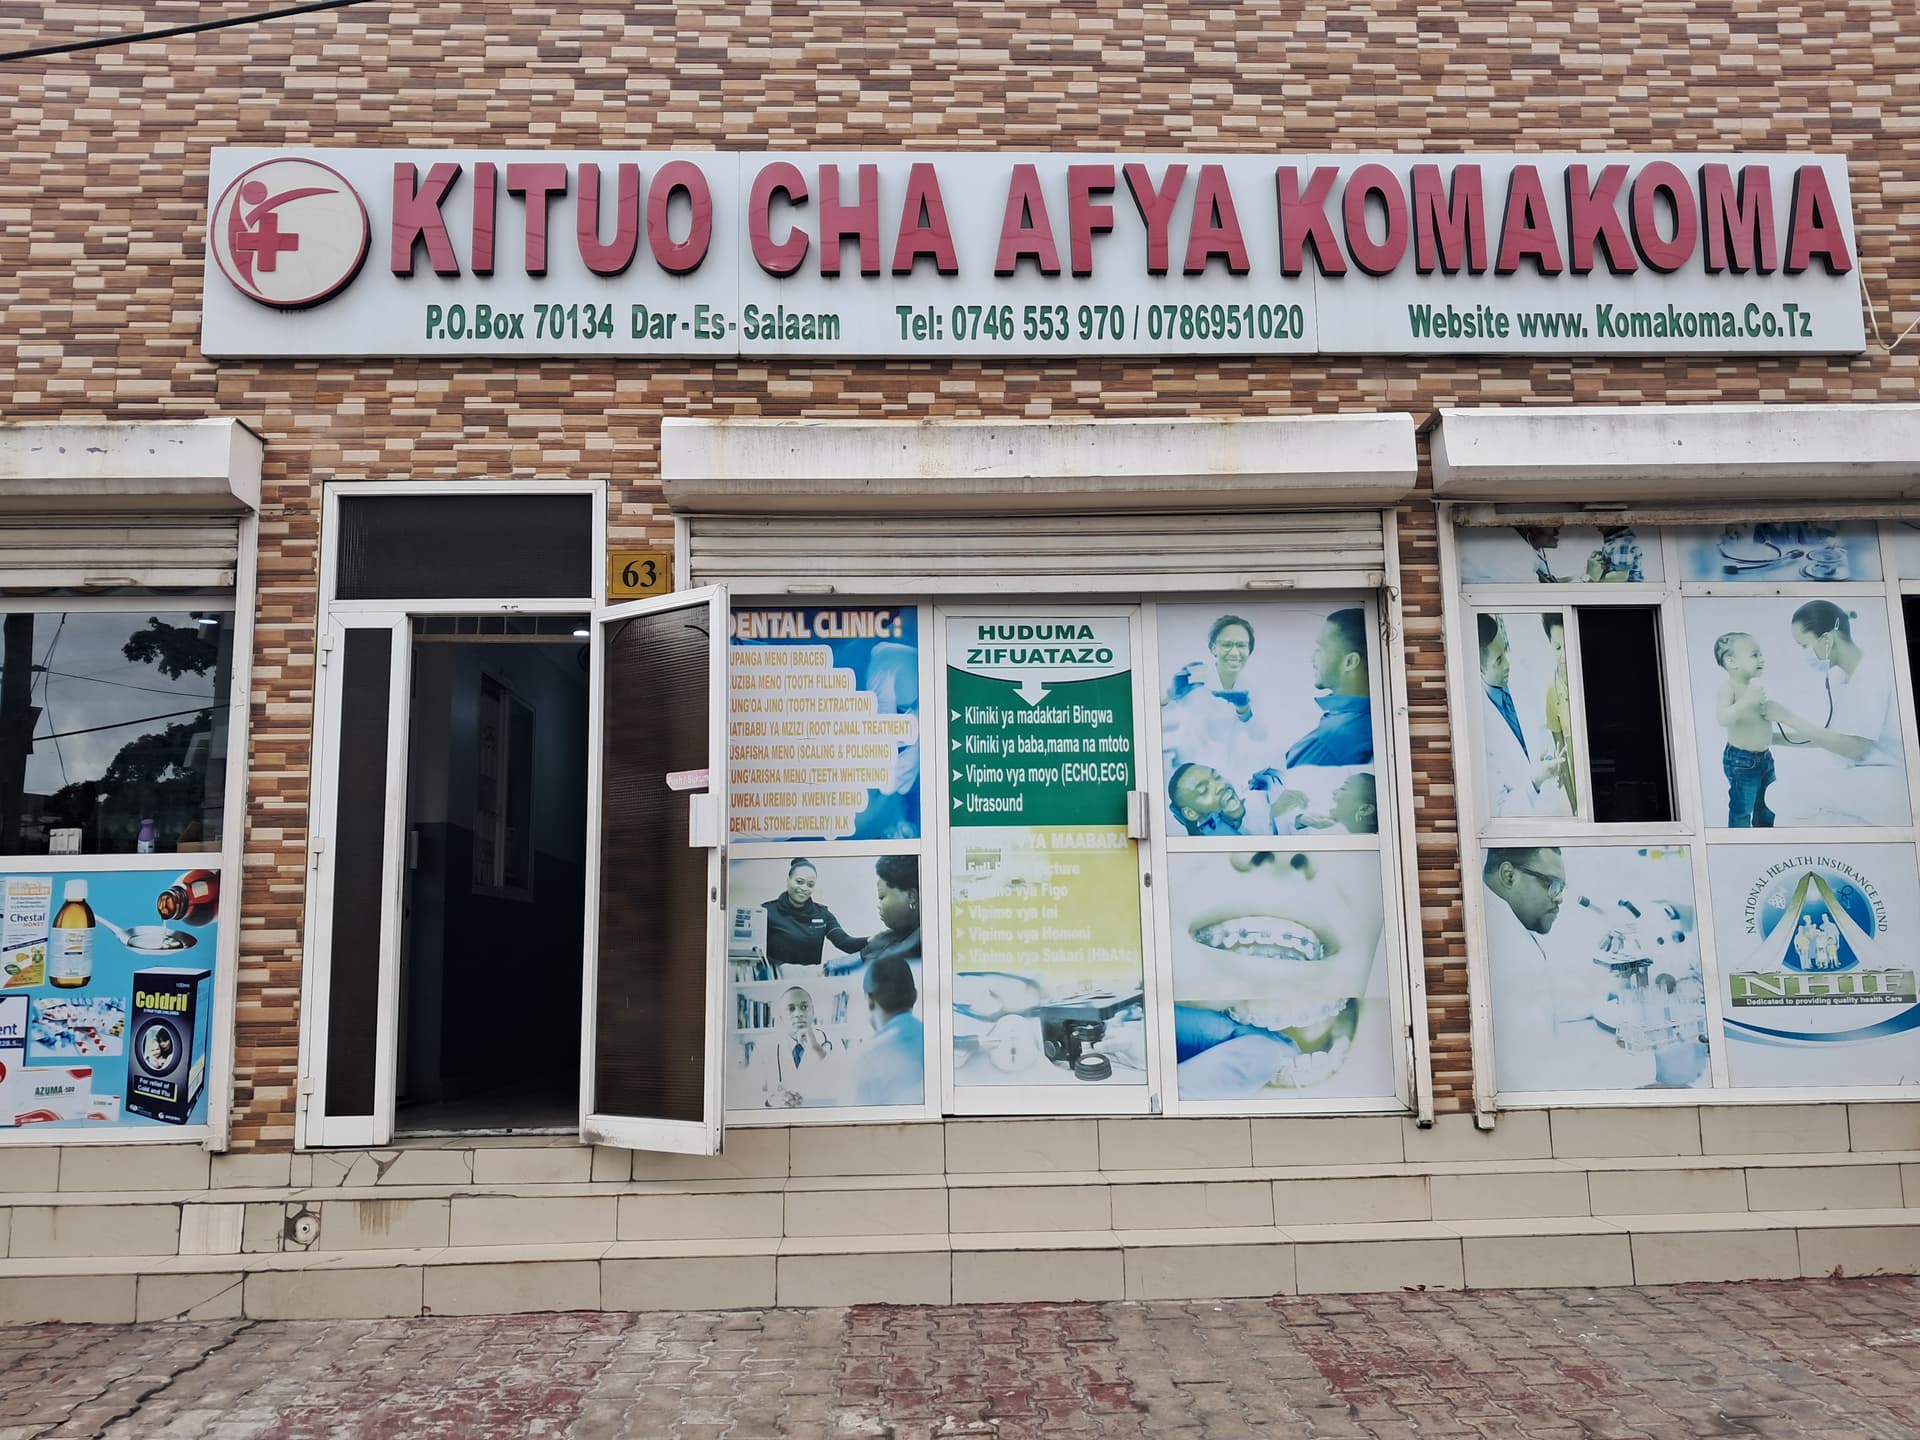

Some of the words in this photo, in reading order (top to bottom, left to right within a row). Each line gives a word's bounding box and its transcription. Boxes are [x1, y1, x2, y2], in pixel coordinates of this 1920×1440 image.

[391, 160, 712, 277] KITUO
[748, 161, 959, 277] CHA
[994, 163, 1250, 277] AFYA
[1275, 160, 1852, 277] KOMAKOMA
[426, 303, 525, 340] P.O.Box
[533, 303, 614, 339] 70134
[896, 304, 943, 341] Tel:
[951, 304, 1015, 341] 0746
[1022, 304, 1069, 341] 553
[1077, 304, 1125, 341] 970
[1132, 304, 1140, 341] /
[1147, 304, 1304, 340] 0786951020
[1408, 303, 1510, 339] Website
[622, 560, 657, 588] 63
[978, 625, 1095, 641] HUDUMA
[765, 651, 788, 667] MENO
[790, 651, 827, 668] (BRACES)
[966, 648, 1114, 665] ZIFUATAZO
[730, 674, 756, 690] UZIBA
[758, 674, 782, 689] MENO
[784, 674, 813, 692] (TOOTH
[816, 674, 850, 691] FILLING)
[730, 697, 763, 713] UNG'OA
[764, 697, 784, 713] JINO
[786, 697, 816, 714] (TOOTH
[818, 697, 872, 714] EXTRACTION)
[965, 705, 999, 725] Kliniki
[1001, 709, 1015, 729] ya
[1017, 705, 1070, 725] madaktari
[1072, 705, 1113, 729] Bingwa
[730, 720, 767, 737] ATIBABU
[769, 720, 780, 736] YA
[782, 720, 804, 736] MZIZI
[807, 720, 832, 737] (ROOT
[833, 720, 860, 736] CANAL
[862, 719, 913, 736] TREATMENT)
[772, 744, 796, 760] MENO
[797, 744, 835, 761] (SCALING
[846, 743, 892, 760] POLISHING)
[965, 735, 999, 754] Kliniki
[1002, 739, 1015, 759] ya
[1082, 738, 1096, 753] na
[1098, 734, 1130, 753] mtoto
[783, 768, 807, 783] MENO
[809, 767, 838, 784] (TEETH
[840, 767, 889, 784] WHITENING)
[966, 764, 1004, 787] Vipimo
[1007, 768, 1025, 787] vya
[1028, 768, 1059, 787] moyo
[1061, 762, 1129, 786] (ECHO,ECG)
[763, 791, 798, 808] UREMBO
[801, 791, 837, 807] KWENYE
[839, 791, 862, 807] MENO
[966, 793, 1023, 813] Utrasound
[1051, 832, 1128, 849] MAABARA
[1745, 877, 1768, 934] NATIONAL
[1766, 856, 1813, 878] HEALTH
[1817, 856, 1878, 899] INSURANCE
[1873, 900, 1888, 932] FUND
[10, 913, 45, 923] Chestal
[135, 990, 188, 1012] Coldril
[1746, 997, 1784, 1006] Dedicated
[1785, 997, 1794, 1005] to
[1795, 996, 1832, 1007] providing
[1833, 995, 1858, 1006] quality
[1860, 995, 1884, 1004] health
[1885, 994, 1903, 1003] Care
[35, 1086, 63, 1097] AZUMA
